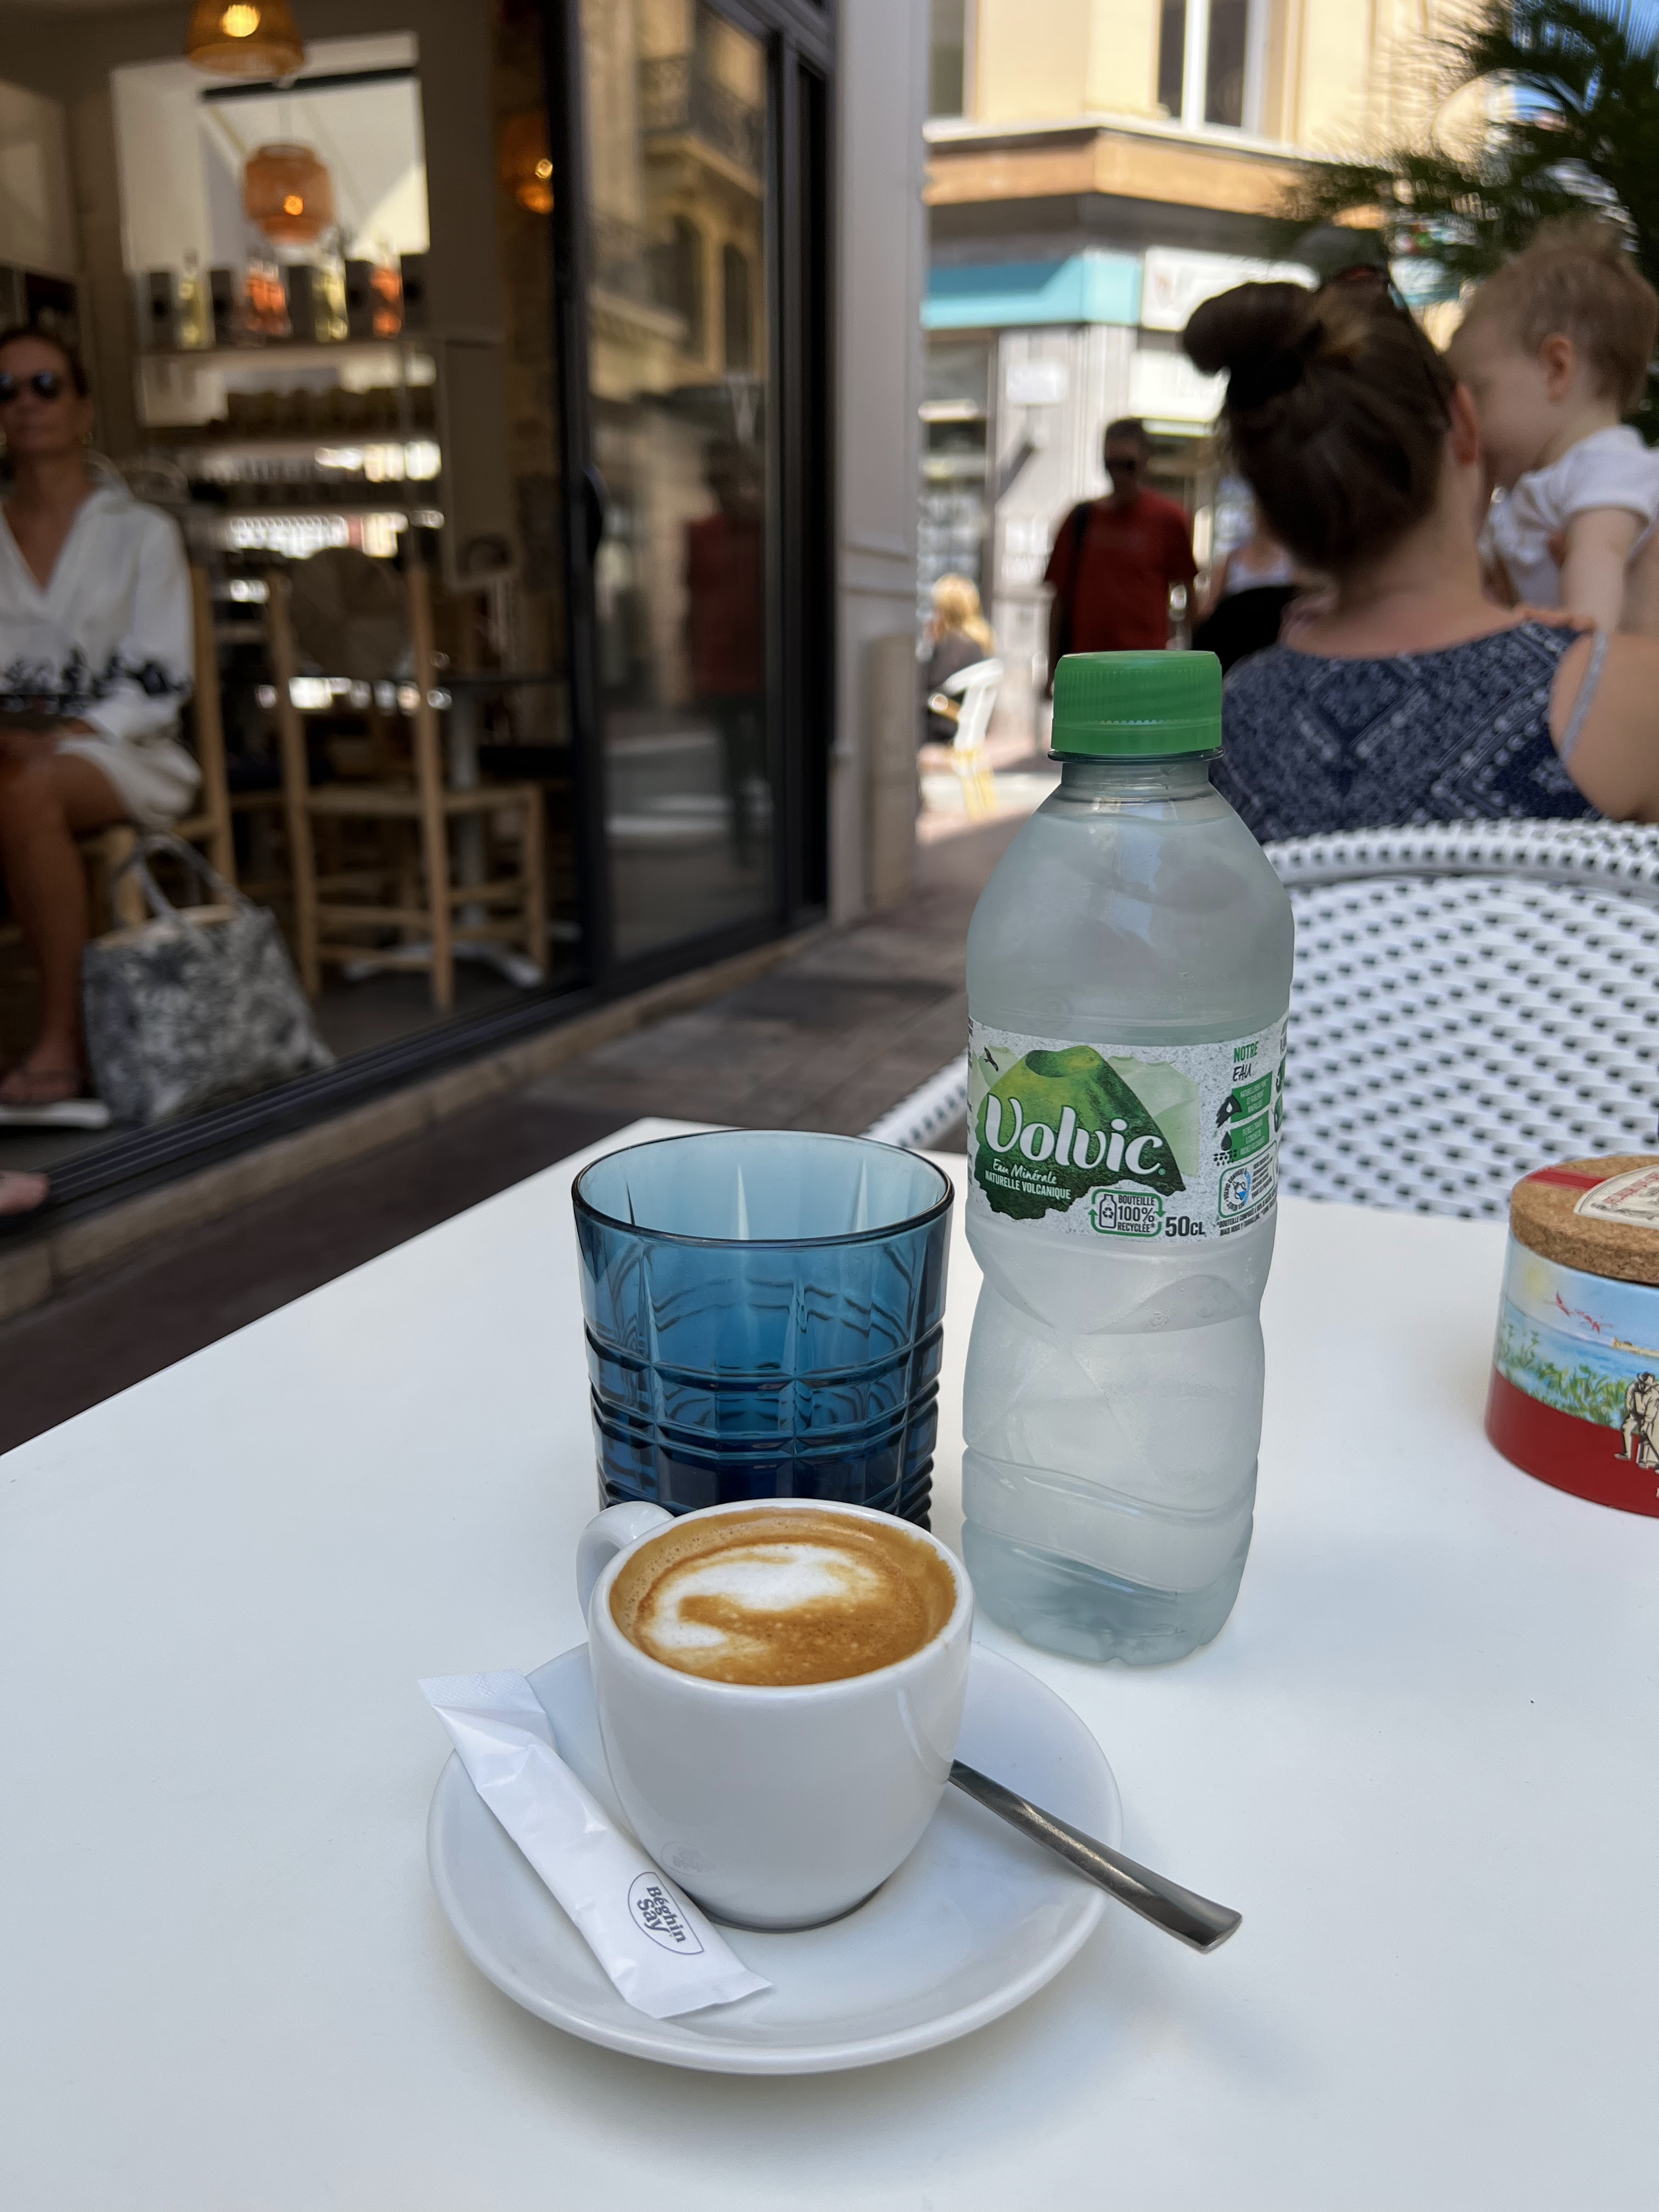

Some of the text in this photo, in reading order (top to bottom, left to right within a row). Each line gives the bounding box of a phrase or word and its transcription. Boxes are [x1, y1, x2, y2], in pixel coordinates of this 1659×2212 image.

[1233, 1041, 1259, 1063] NOTRE
[1233, 1063, 1251, 1081] EAU
[984, 1092, 1164, 1175] Volvic
[985, 1170, 1071, 1200] NATURELLE VOLCANIQUE
[992, 1158, 1057, 1185] Eau Minérale
[1118, 1195, 1155, 1206] BOUTEILLE
[1118, 1206, 1155, 1222] 100%
[636, 1898, 670, 1933] Say
[646, 1886, 686, 1943] Béghin
